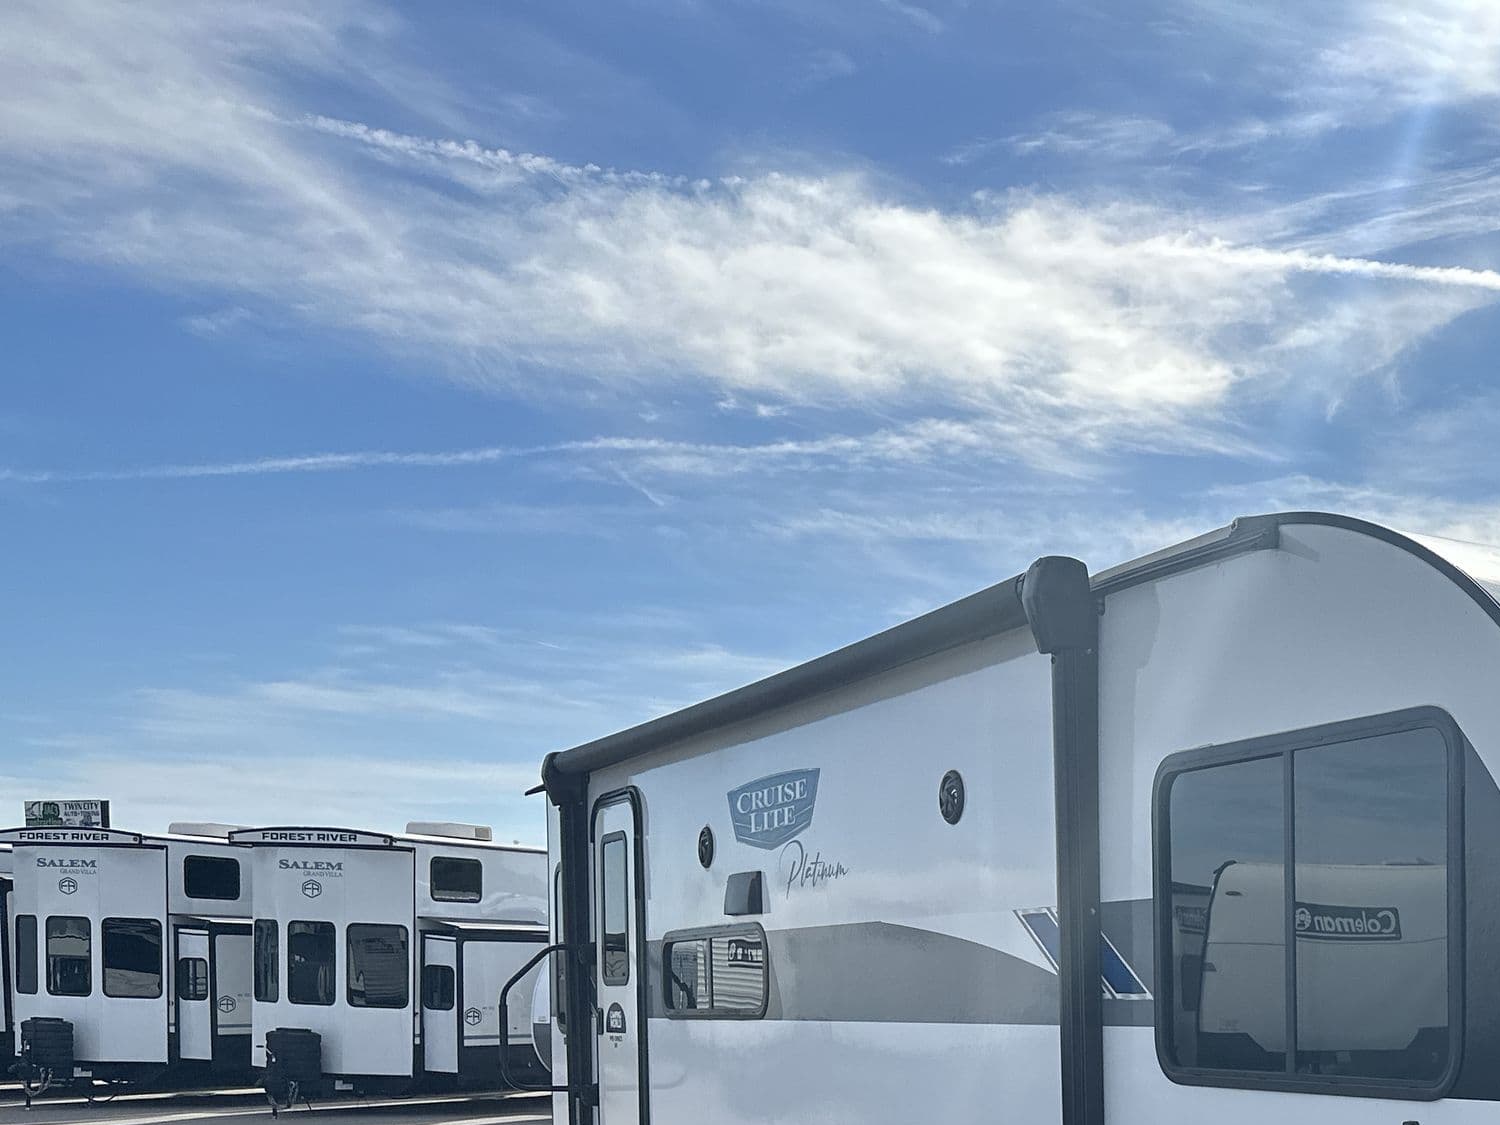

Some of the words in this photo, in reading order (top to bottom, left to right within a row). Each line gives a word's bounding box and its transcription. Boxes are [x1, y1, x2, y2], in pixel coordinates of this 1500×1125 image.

[736, 778, 808, 814] CRUISE
[749, 804, 797, 833] LITE
[19, 832, 69, 841] FOREST
[71, 833, 110, 841] RIVER
[261, 832, 315, 842] FOREST
[317, 833, 358, 843] RIVER
[36, 857, 97, 869] SALEM
[278, 859, 344, 871] SALEM
[779, 839, 850, 900] Platinum
